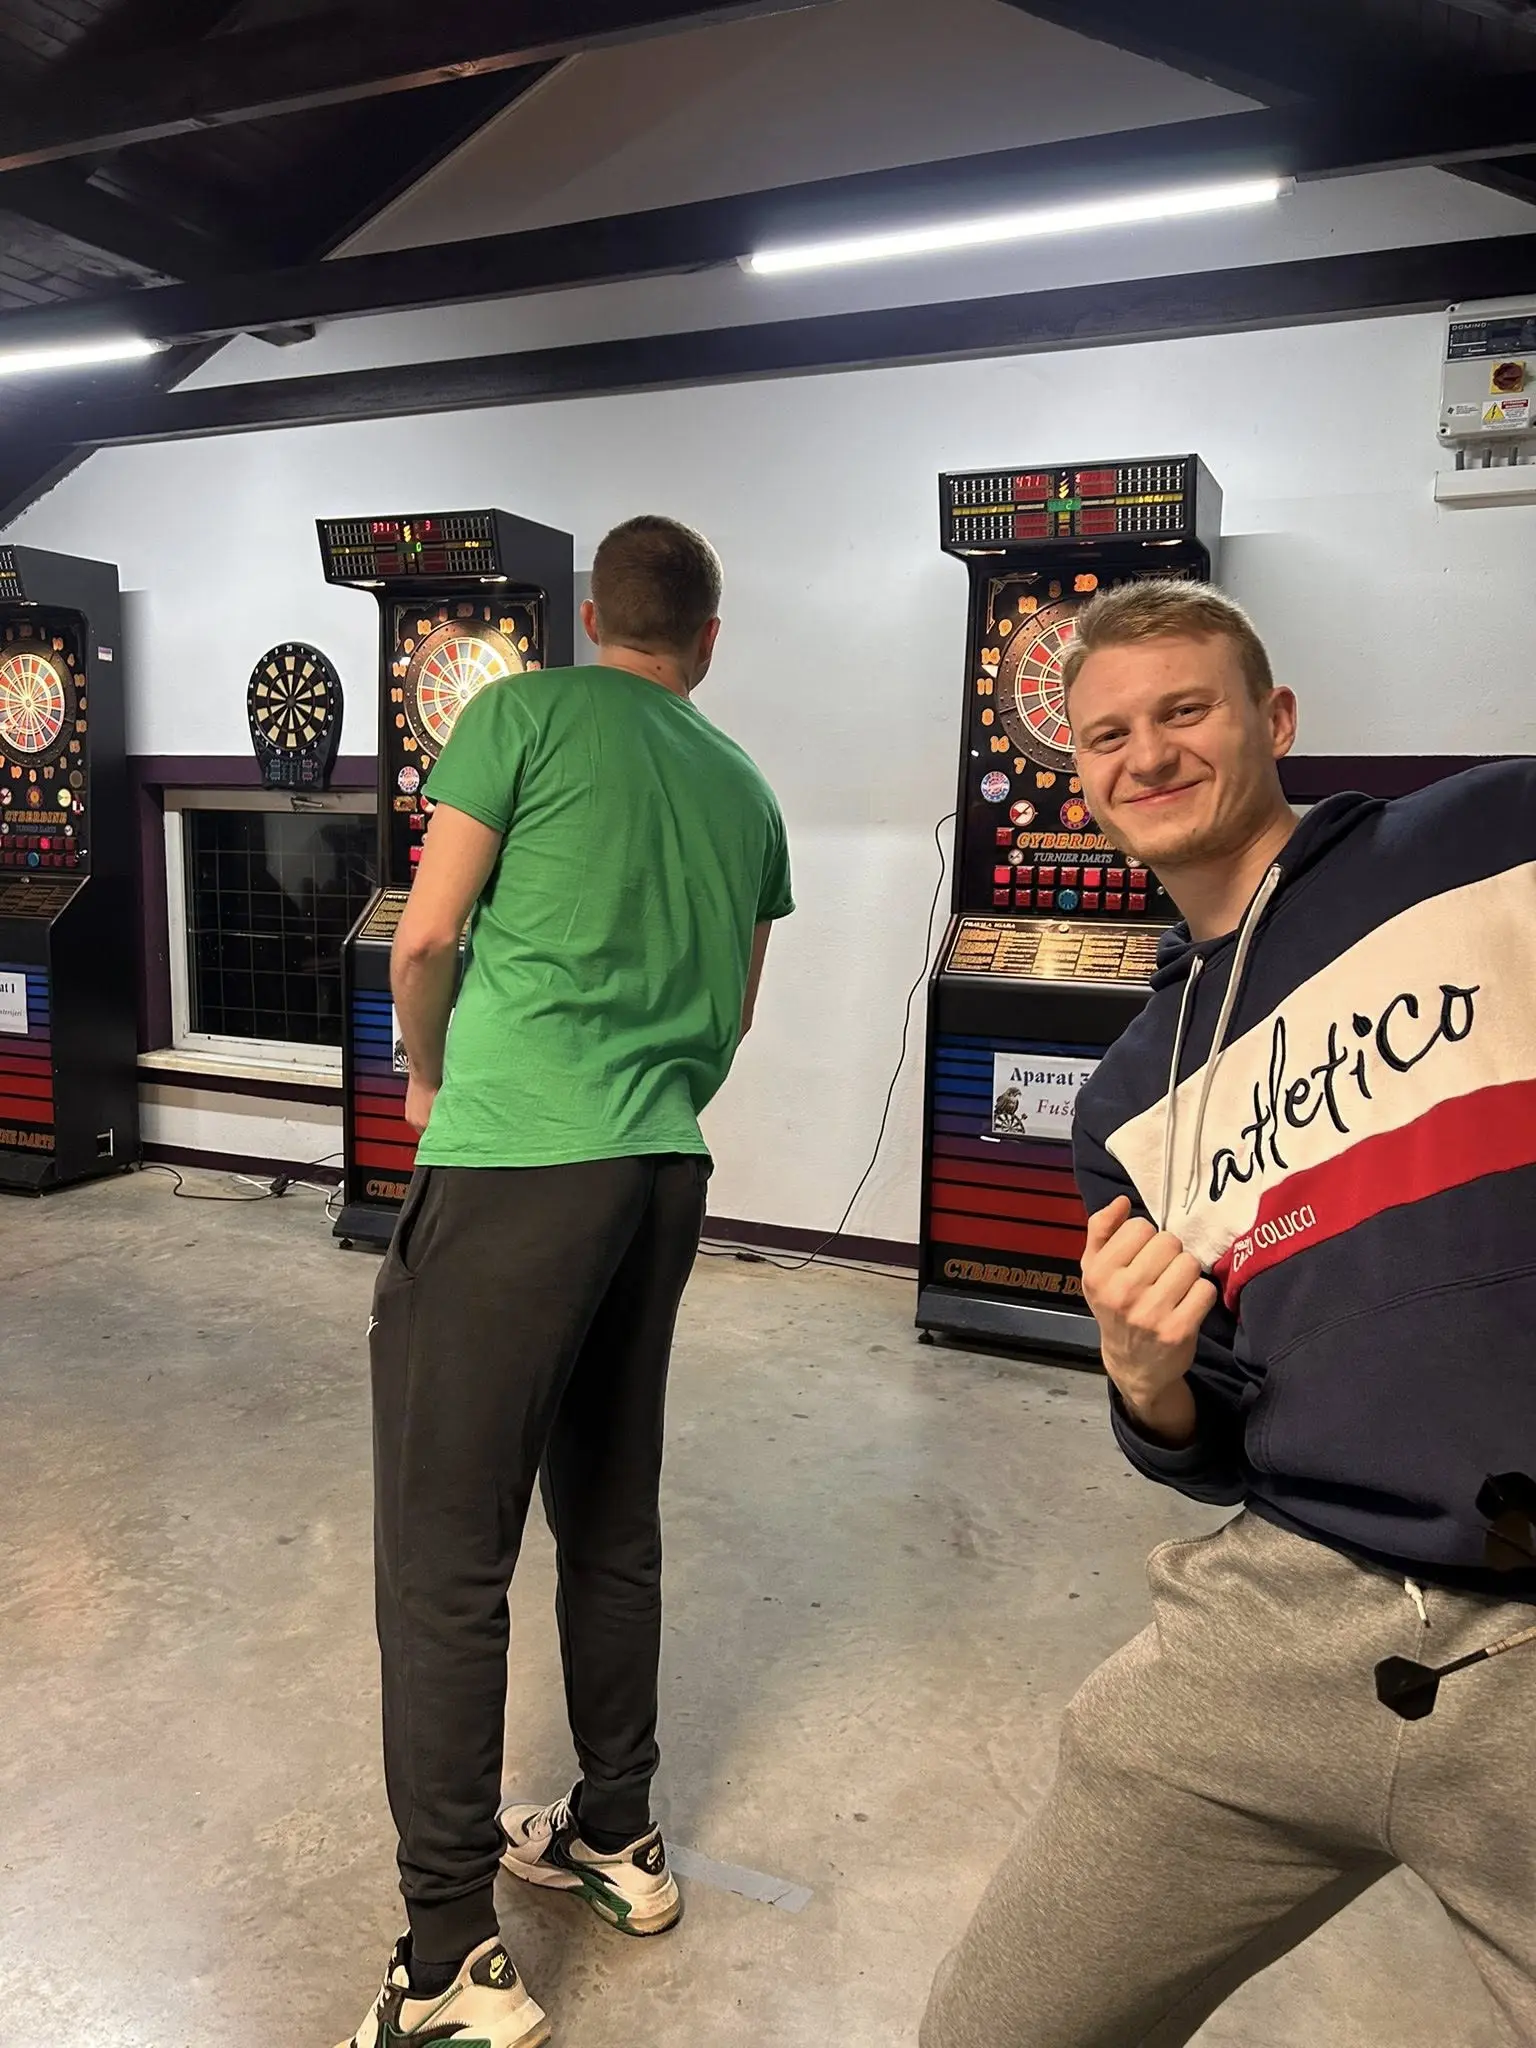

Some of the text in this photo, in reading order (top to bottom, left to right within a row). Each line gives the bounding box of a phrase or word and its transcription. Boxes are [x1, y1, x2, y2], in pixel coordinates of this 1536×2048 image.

[1016, 474, 1040, 488] 471
[425, 520, 431, 531] 3
[1073, 572, 1099, 593] 20
[976, 677, 994, 696] 11
[990, 735, 1010, 753] 16
[1013, 756, 1027, 775] 7
[1035, 771, 1057, 789] 19
[1033, 852, 1113, 864] TURNIER DARTS
[1010, 1067, 1074, 1086] Aparat
[1254, 1204, 1316, 1249] COLUCCI
[944, 1258, 1063, 1293] CYBERDINE
